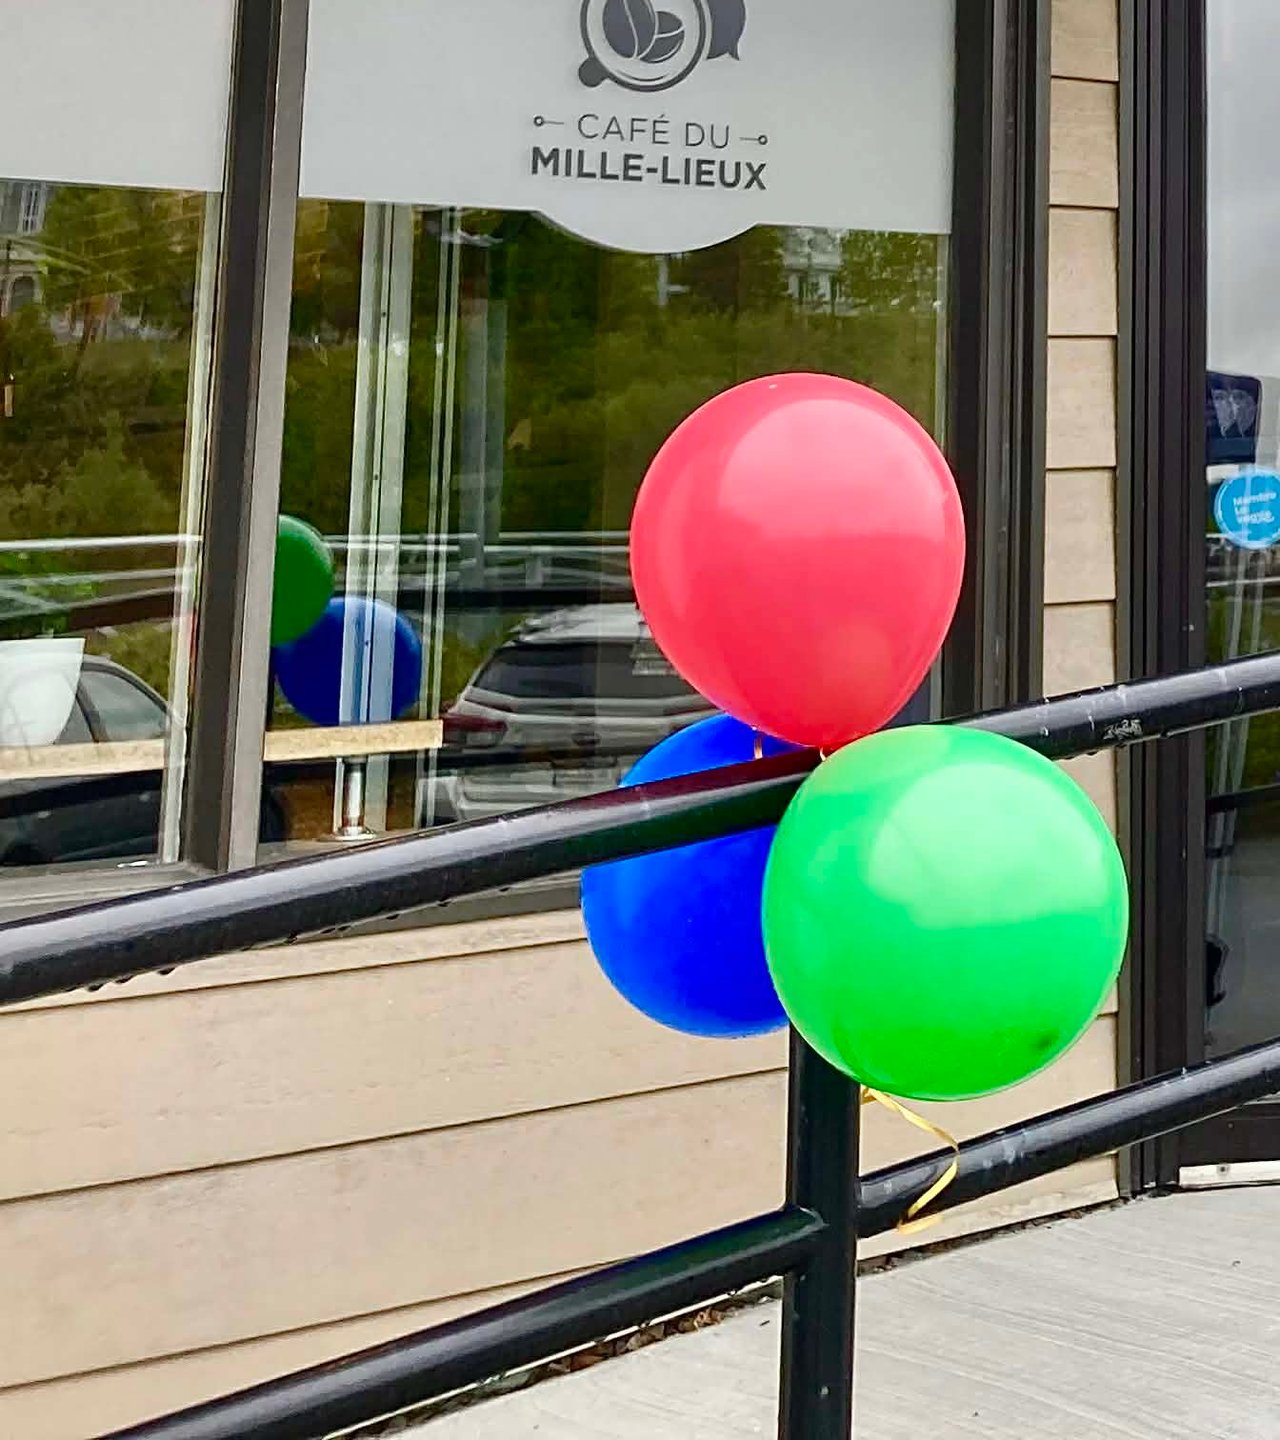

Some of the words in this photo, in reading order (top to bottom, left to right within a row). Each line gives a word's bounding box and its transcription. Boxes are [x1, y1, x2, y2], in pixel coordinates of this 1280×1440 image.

[577, 113, 671, 145] CAFÉ
[685, 122, 730, 149] DU
[531, 146, 767, 190] MILLE-LIEUX
